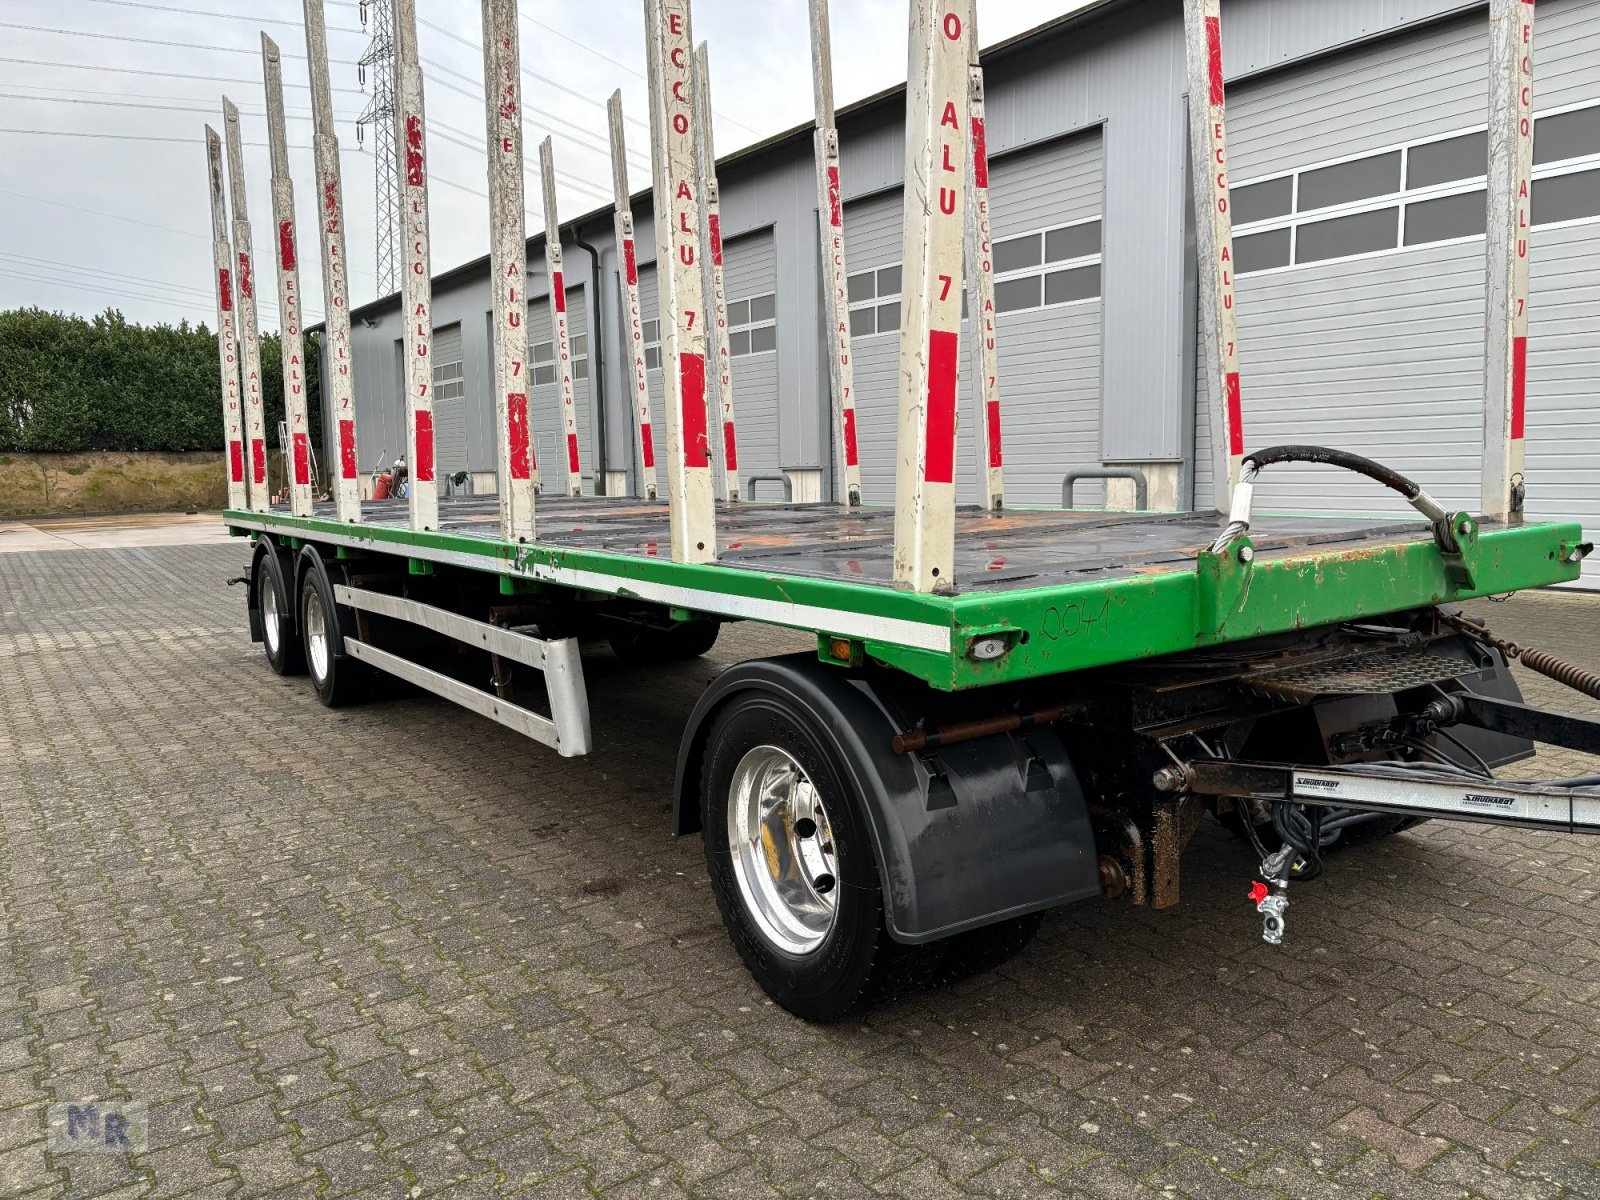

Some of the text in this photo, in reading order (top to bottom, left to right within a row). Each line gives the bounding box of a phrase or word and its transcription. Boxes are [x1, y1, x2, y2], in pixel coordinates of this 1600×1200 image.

[669, 13, 696, 330] ECCO ALU 7
[939, 102, 958, 215] ALU
[1517, 24, 1530, 316] ECCO ALU 7
[939, 275, 951, 301] 7
[979, 201, 995, 388] ECCO ALU 7
[1215, 123, 1234, 358] ECCO ALU 7
[224, 319, 238, 433] ECCO ALU 7
[286, 280, 302, 424] ECCO ALU 7
[416, 304, 428, 357] ALU
[512, 361, 521, 376] 7
[559, 319, 574, 427] ECCO ALU 7
[629, 293, 647, 416] ECCO ALU 7
[715, 276, 726, 329] ECCO
[725, 403, 730, 412] 7
[838, 322, 848, 365] ALU
[844, 387, 849, 398] 7
[250, 372, 260, 431] ALU 7
[341, 398, 349, 408] 7
[420, 384, 427, 397] 7
[1043, 599, 1110, 640] 0041
